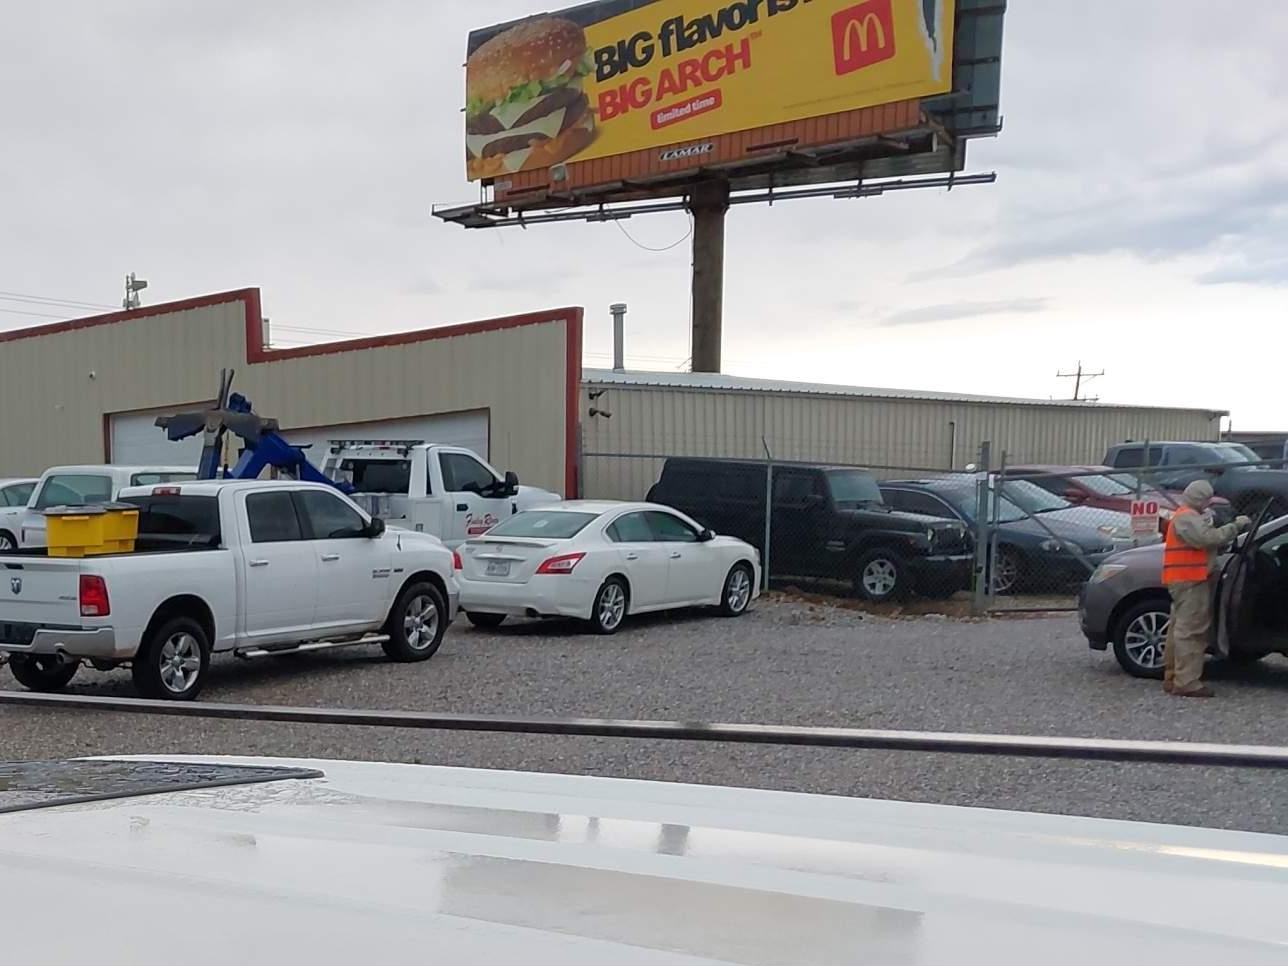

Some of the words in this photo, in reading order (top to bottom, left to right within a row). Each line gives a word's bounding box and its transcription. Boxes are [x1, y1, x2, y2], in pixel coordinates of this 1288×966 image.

[594, 31, 655, 82] BIG
[598, 77, 652, 122] BIG
[657, 102, 691, 124] limited
[692, 96, 715, 111] time
[662, 143, 711, 160] LAMAR
[1133, 502, 1158, 515] NO
